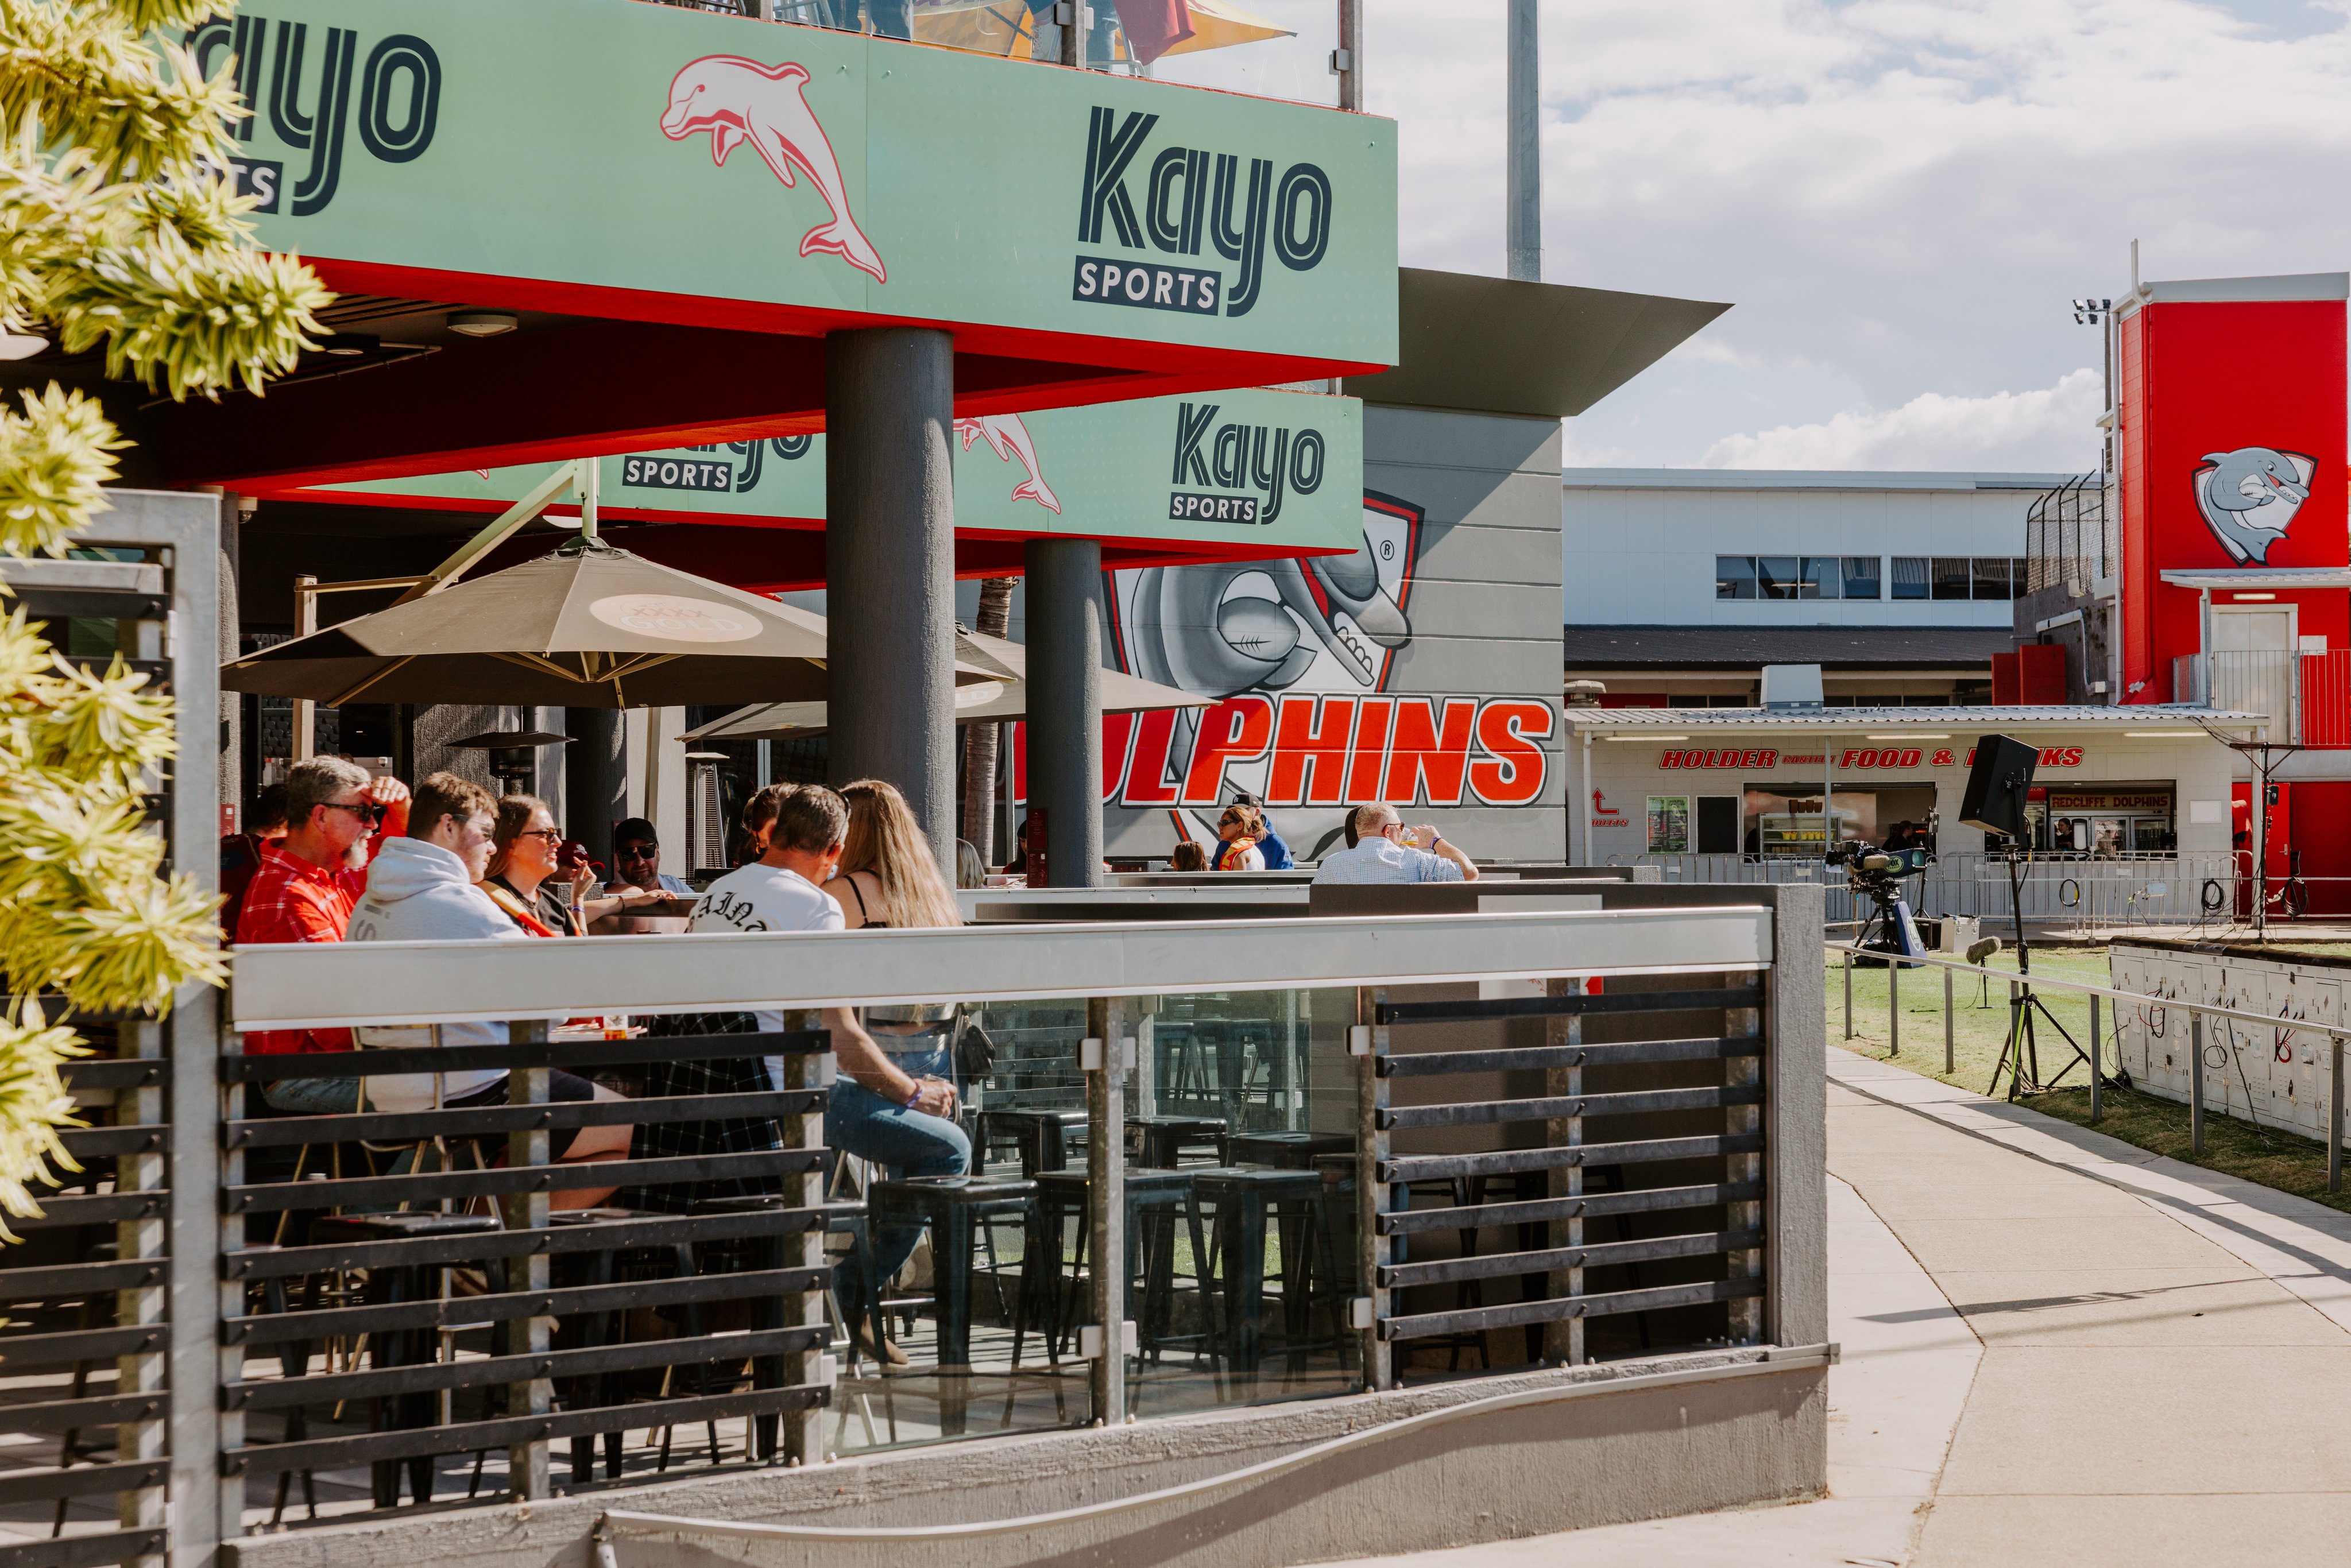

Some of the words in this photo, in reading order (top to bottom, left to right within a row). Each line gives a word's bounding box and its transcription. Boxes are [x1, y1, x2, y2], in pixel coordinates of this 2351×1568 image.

[1078, 106, 1332, 317] Kayo
[1078, 262, 1216, 308] SPORTS
[626, 460, 728, 488] SPORTS
[1172, 402, 1325, 525] Kayo
[1172, 495, 1255, 520] SPORTS
[632, 607, 713, 618] XXXX
[619, 615, 745, 632] GOLD
[1660, 749, 1778, 769] HOLDER
[1839, 748, 1923, 769] FOOD
[1930, 748, 1955, 767] &
[2052, 796, 2106, 808] REDCLIFFE
[2113, 796, 2168, 807] DOLPHINS
[1592, 819, 1629, 827] OILETS
[1888, 859, 1899, 867] OX
